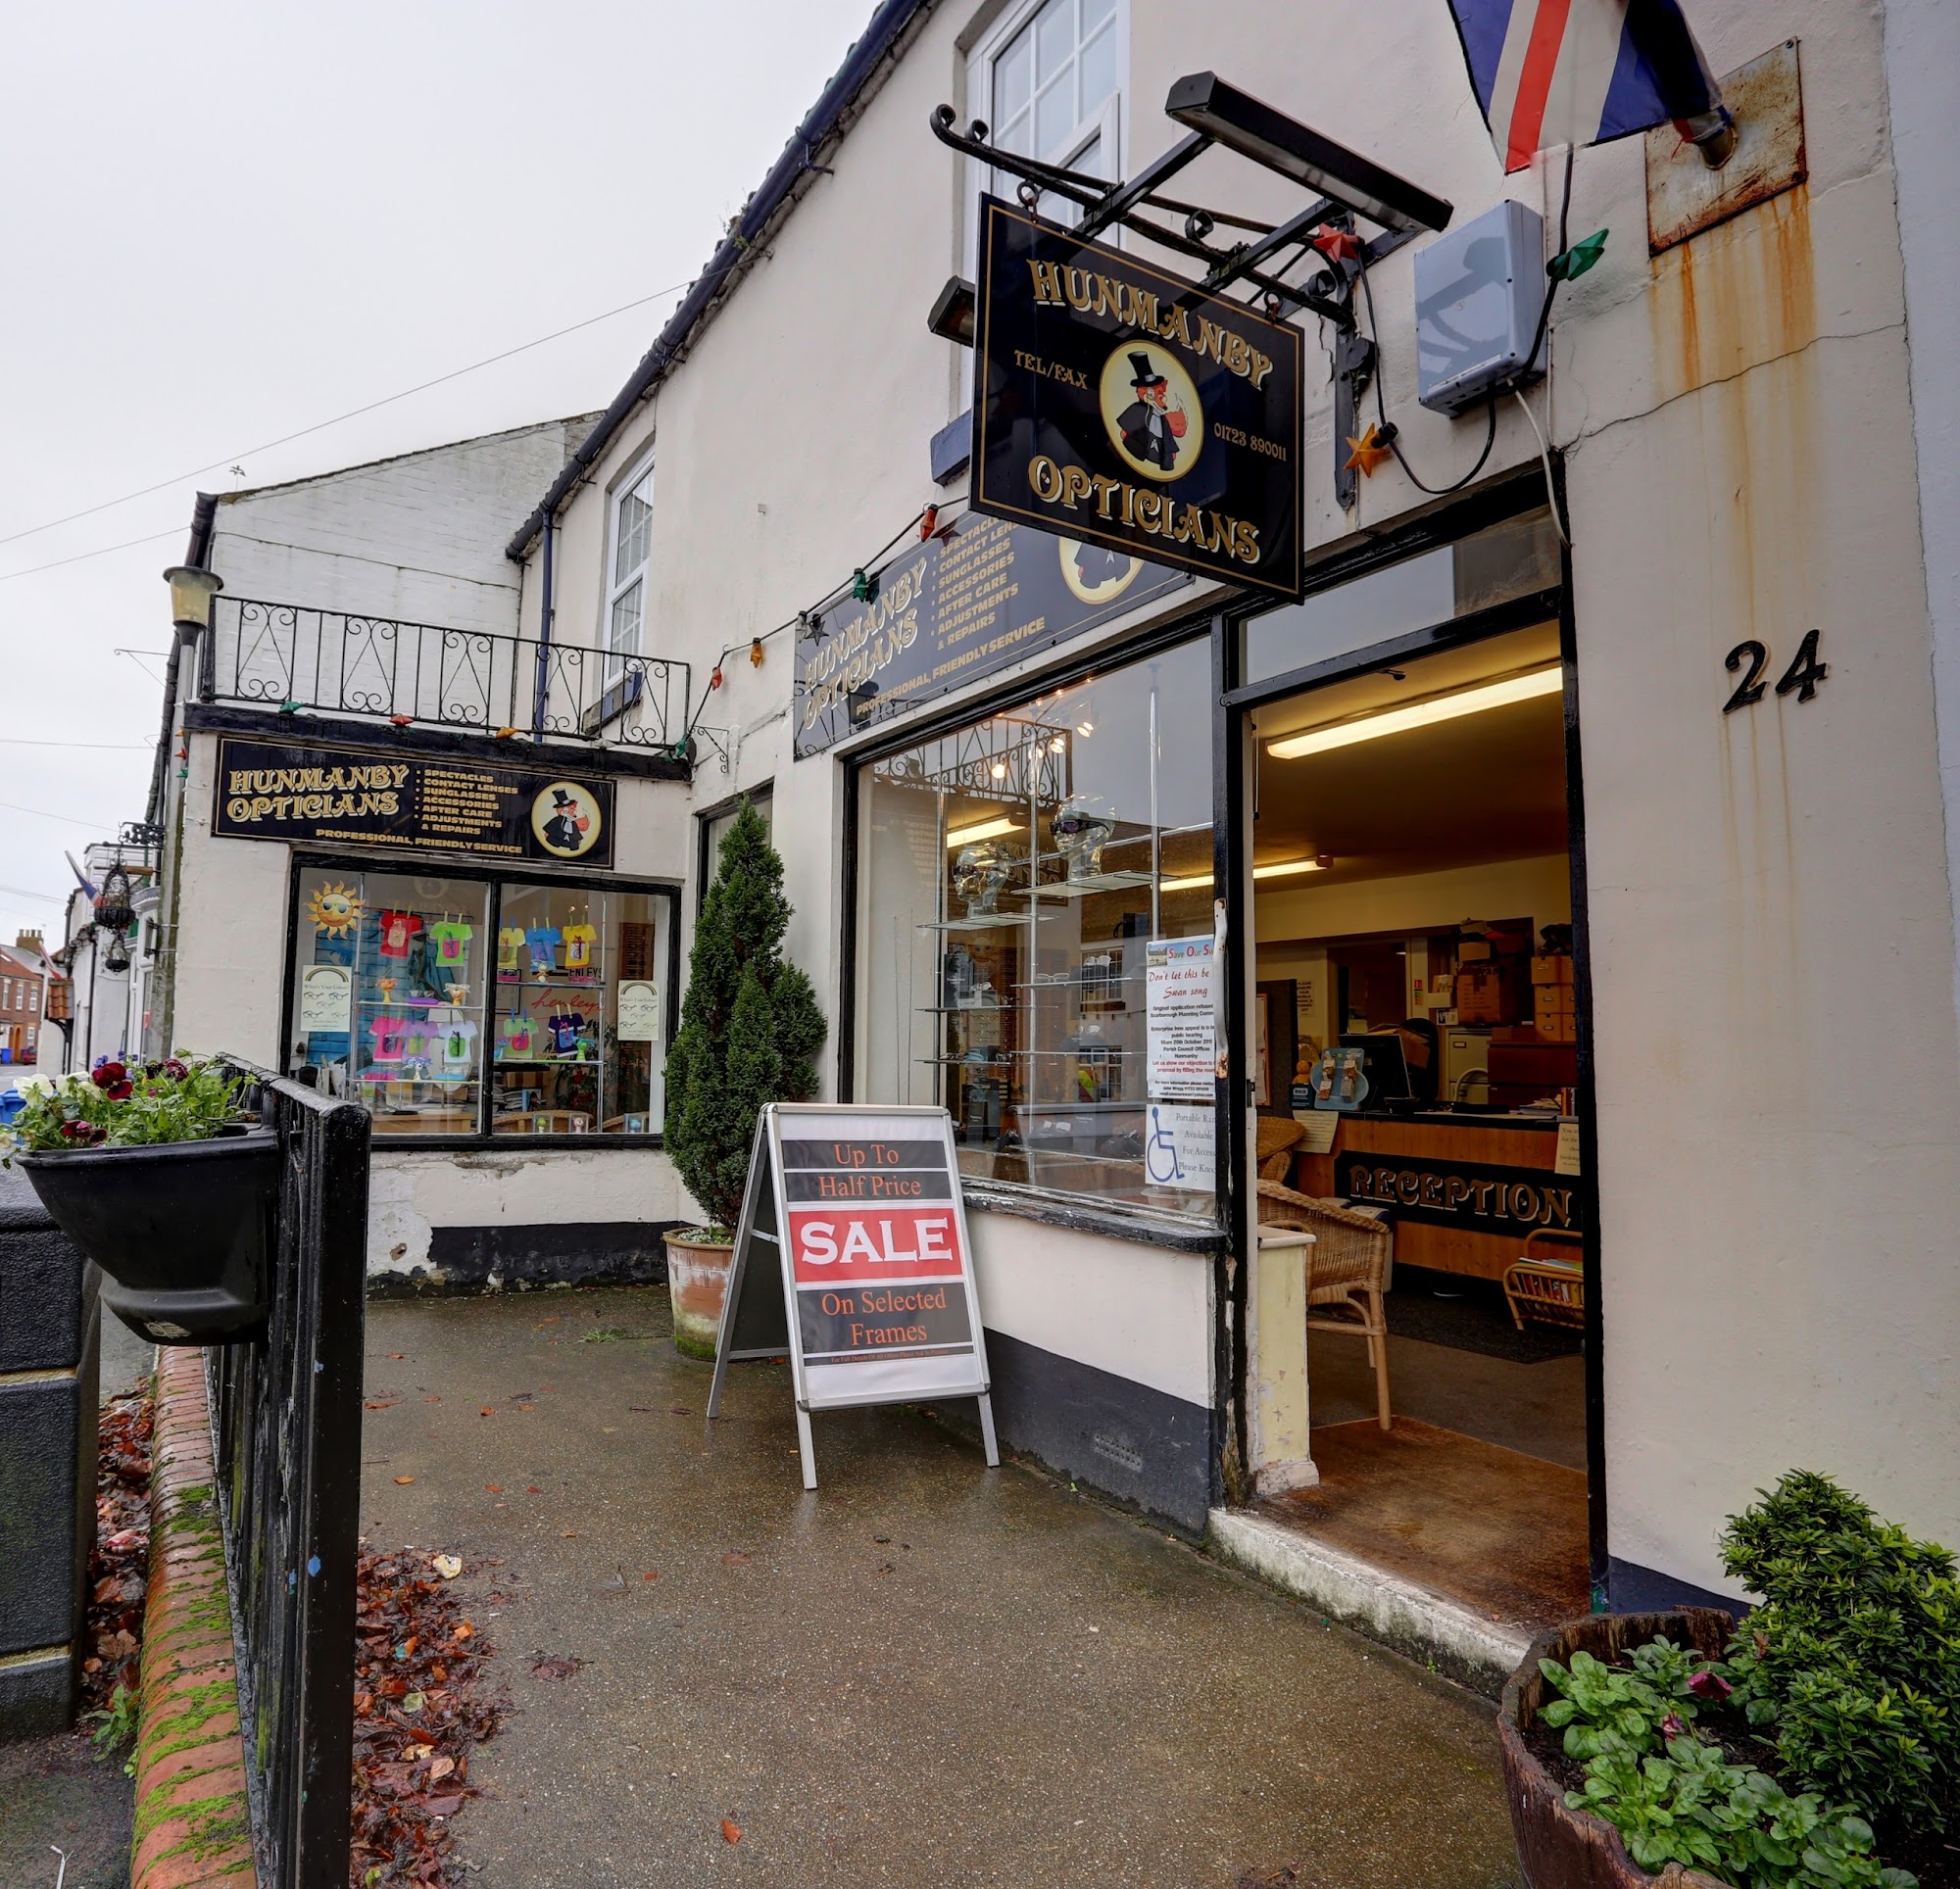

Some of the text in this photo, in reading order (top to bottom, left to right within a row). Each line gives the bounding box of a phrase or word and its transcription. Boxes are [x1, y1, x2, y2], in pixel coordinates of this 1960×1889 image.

[1026, 259, 1273, 391] HUNMANBY
[1014, 349, 1088, 390] TEL/FAX
[1213, 422, 1287, 461] 01723 890011
[1027, 455, 1260, 564] OPTICIANS
[940, 516, 1002, 558] SPECTACLE
[939, 535, 988, 573] CONTACT
[939, 537, 1010, 589] SUNGLASSES
[938, 552, 1014, 605] ACCESSORIES
[938, 572, 1007, 620] AFTER CARE
[938, 582, 1019, 635] ADJUSTMENTS
[805, 557, 927, 696] HUNMANBY
[937, 611, 996, 651] & REPAIRS
[804, 606, 918, 730] OPTICIANS
[856, 615, 1046, 716] PROFESSIONAL, FRIENDLY SERVICE
[1723, 629, 1828, 714] 24
[227, 764, 410, 795] HUNMANBY
[423, 769, 494, 783] SPECTACLES
[423, 778, 518, 795] CONTACT LENSES
[226, 791, 400, 823] OPTICIANS
[422, 787, 497, 800] SUNGLASSES
[422, 796, 500, 810] ACCESSORIES
[421, 805, 493, 818] AFTER CARE
[421, 814, 503, 828] ADJUSTMENTS
[315, 828, 522, 854] PROFESSIONAL, FRIENDLY SERVICE
[431, 824, 481, 835] REPAIRS
[1168, 947, 1185, 959] Save
[1186, 945, 1201, 957] Our
[1148, 967, 1209, 983] Don't let this be
[1162, 986, 1208, 999] Swan song
[1175, 1112, 1201, 1123] Portable
[1182, 1145, 1194, 1154] For
[1184, 1130, 1213, 1140] Available
[833, 1143, 899, 1169] Up To
[1178, 1161, 1216, 1174] Please Knoc
[818, 1176, 922, 1197] Half Price
[1348, 1164, 1573, 1228] RECEPTION
[800, 1217, 953, 1265] SALE
[821, 1286, 947, 1316] On Selected
[851, 1323, 927, 1346] Frames
